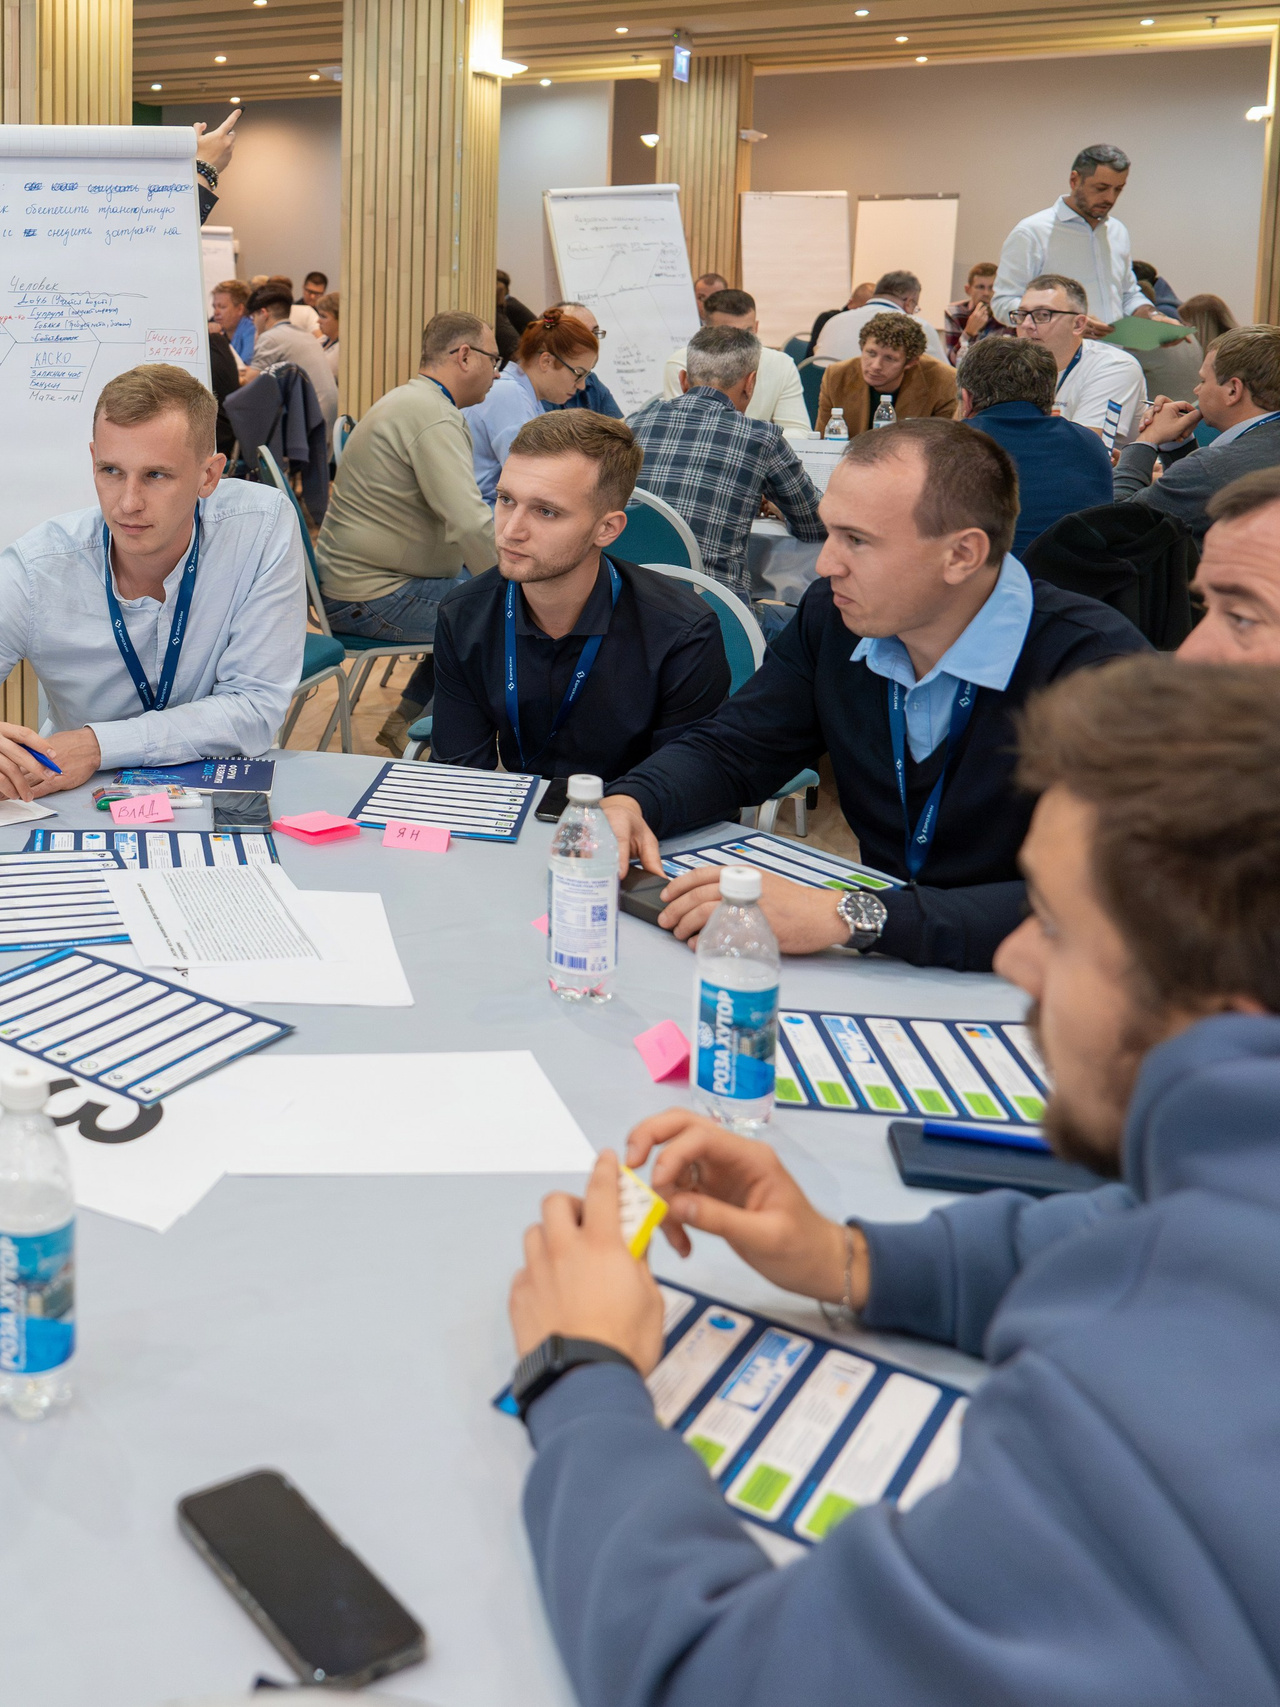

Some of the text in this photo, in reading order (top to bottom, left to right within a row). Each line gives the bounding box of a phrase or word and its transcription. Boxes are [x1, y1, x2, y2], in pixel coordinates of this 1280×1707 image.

[25, 203, 90, 215] обеспечить
[97, 205, 176, 221] транспортную
[47, 227, 93, 246] снизить
[164, 227, 181, 237] на
[10, 275, 60, 292] Человек
[34, 352, 72, 366] КАСКО
[149, 346, 199, 357] ЗАТРАТЫ
[118, 800, 159, 818] ВЛАД
[397, 827, 420, 841] ЯН
[712, 990, 734, 1095] РОЗА ХУТОР
